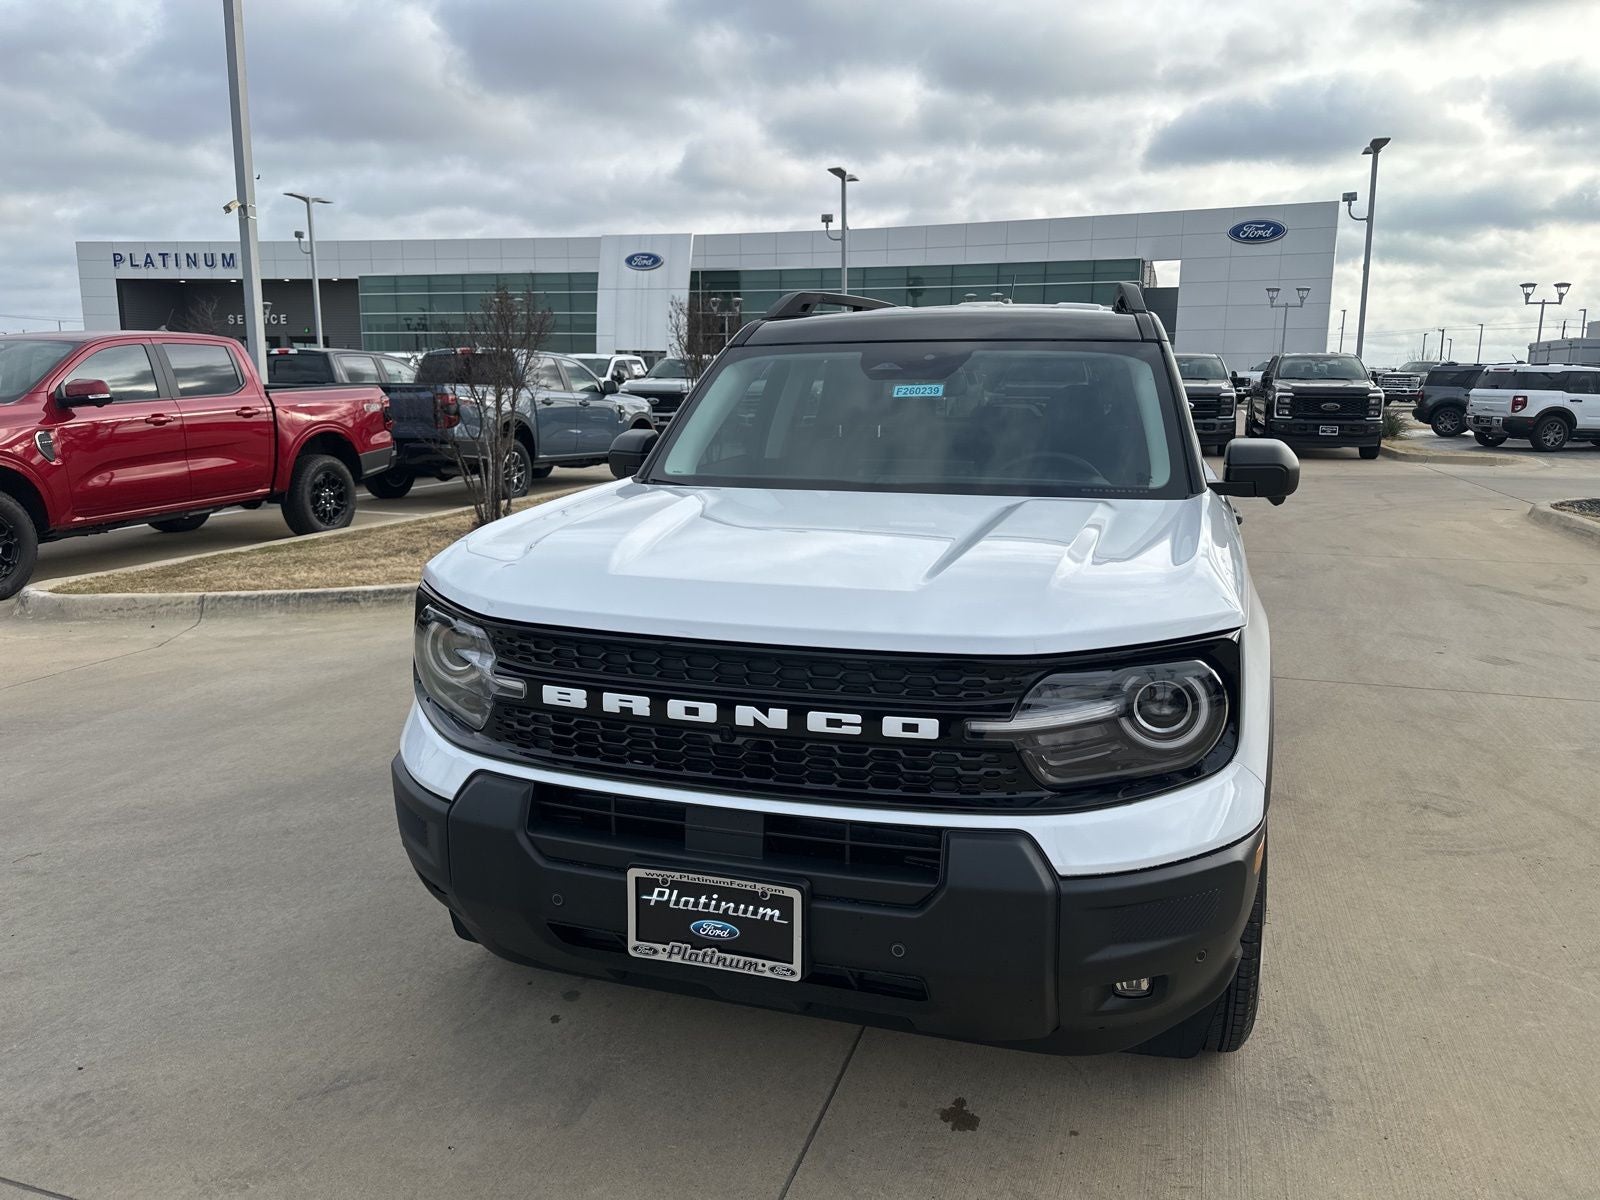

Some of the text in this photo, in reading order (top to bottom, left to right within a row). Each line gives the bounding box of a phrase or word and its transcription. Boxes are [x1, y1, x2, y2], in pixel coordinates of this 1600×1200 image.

[1240, 223, 1274, 238] Ford
[112, 252, 237, 269] PLATINUM
[227, 314, 287, 325] SEICE
[896, 386, 940, 395] F260239
[542, 684, 940, 740] BRONCO
[645, 871, 785, 895] www.PlatinumFord.com
[640, 887, 789, 924] Platinum
[699, 922, 730, 938] Ford
[666, 944, 767, 974] Platinum
